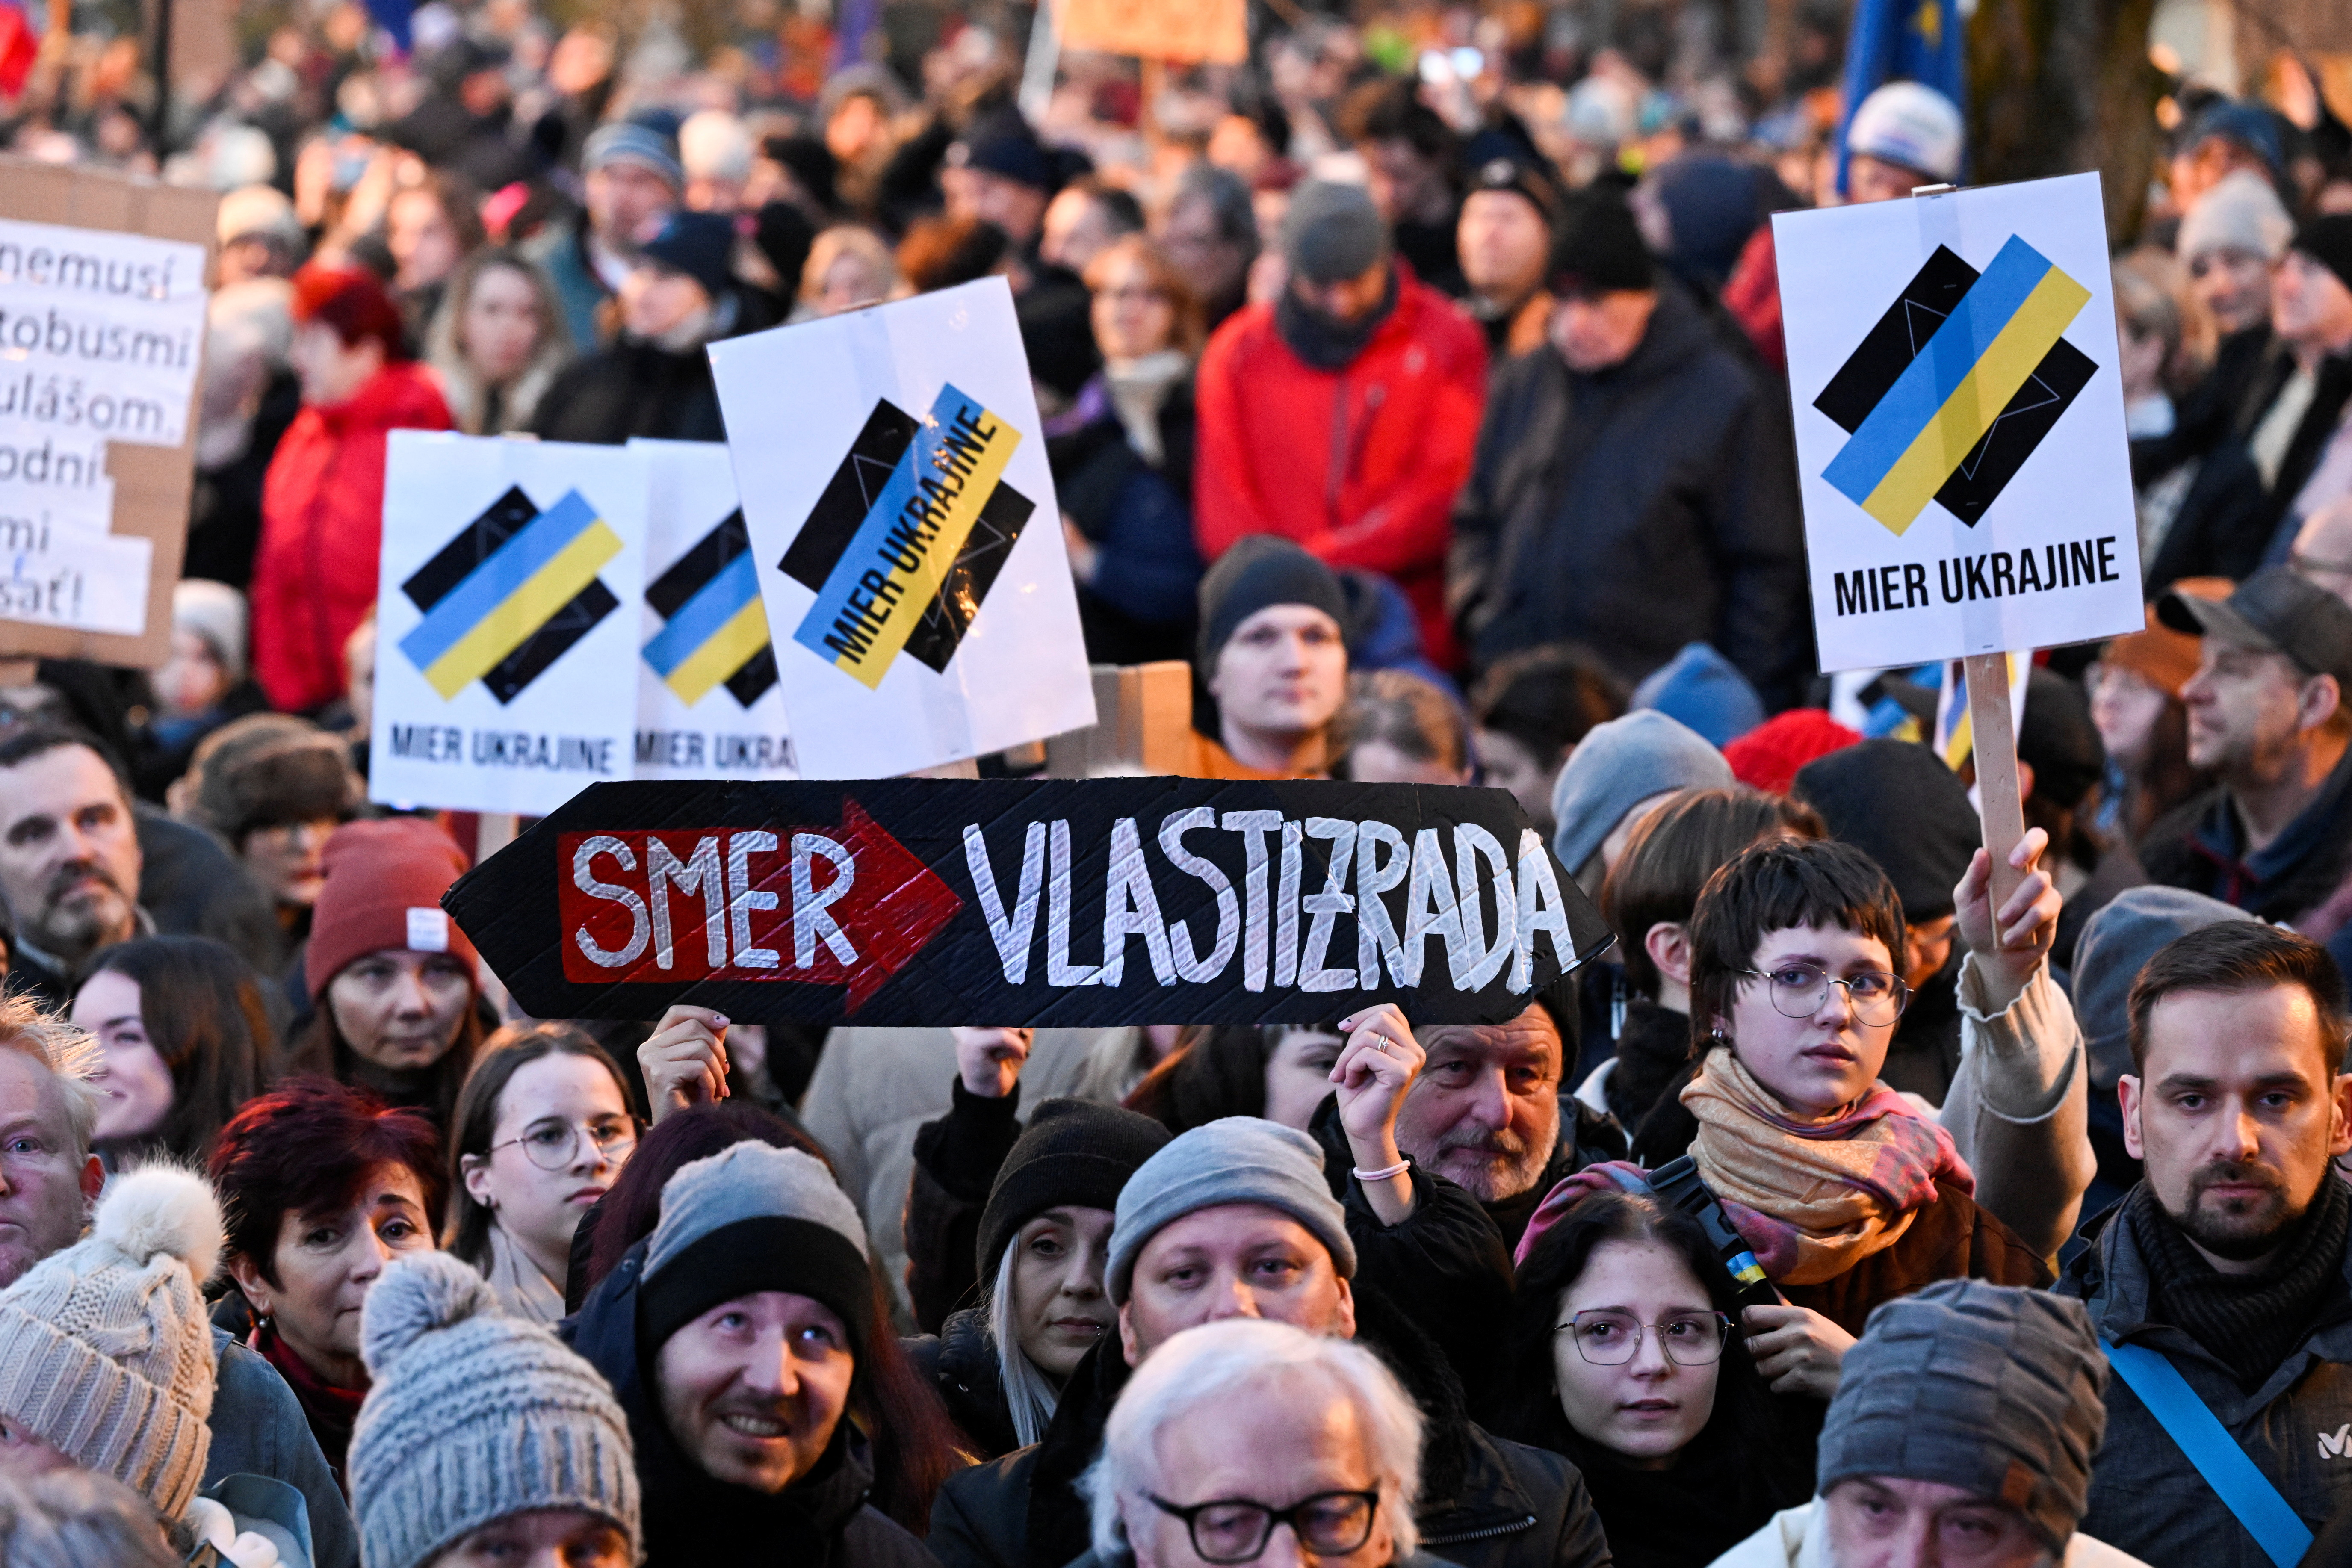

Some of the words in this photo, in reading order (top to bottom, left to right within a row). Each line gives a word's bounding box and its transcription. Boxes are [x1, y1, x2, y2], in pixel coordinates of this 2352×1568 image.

[823, 568, 905, 664] MIER
[878, 405, 997, 573] UKRAJINE
[1833, 563, 1929, 616] MIER
[1939, 536, 2120, 604] UKRAJINE
[390, 724, 462, 763] MIER
[472, 729, 616, 775] UKRAJINE
[635, 729, 705, 769] MIER
[573, 831, 859, 970] SMER
[963, 806, 1581, 995] VLASTIZRADA
